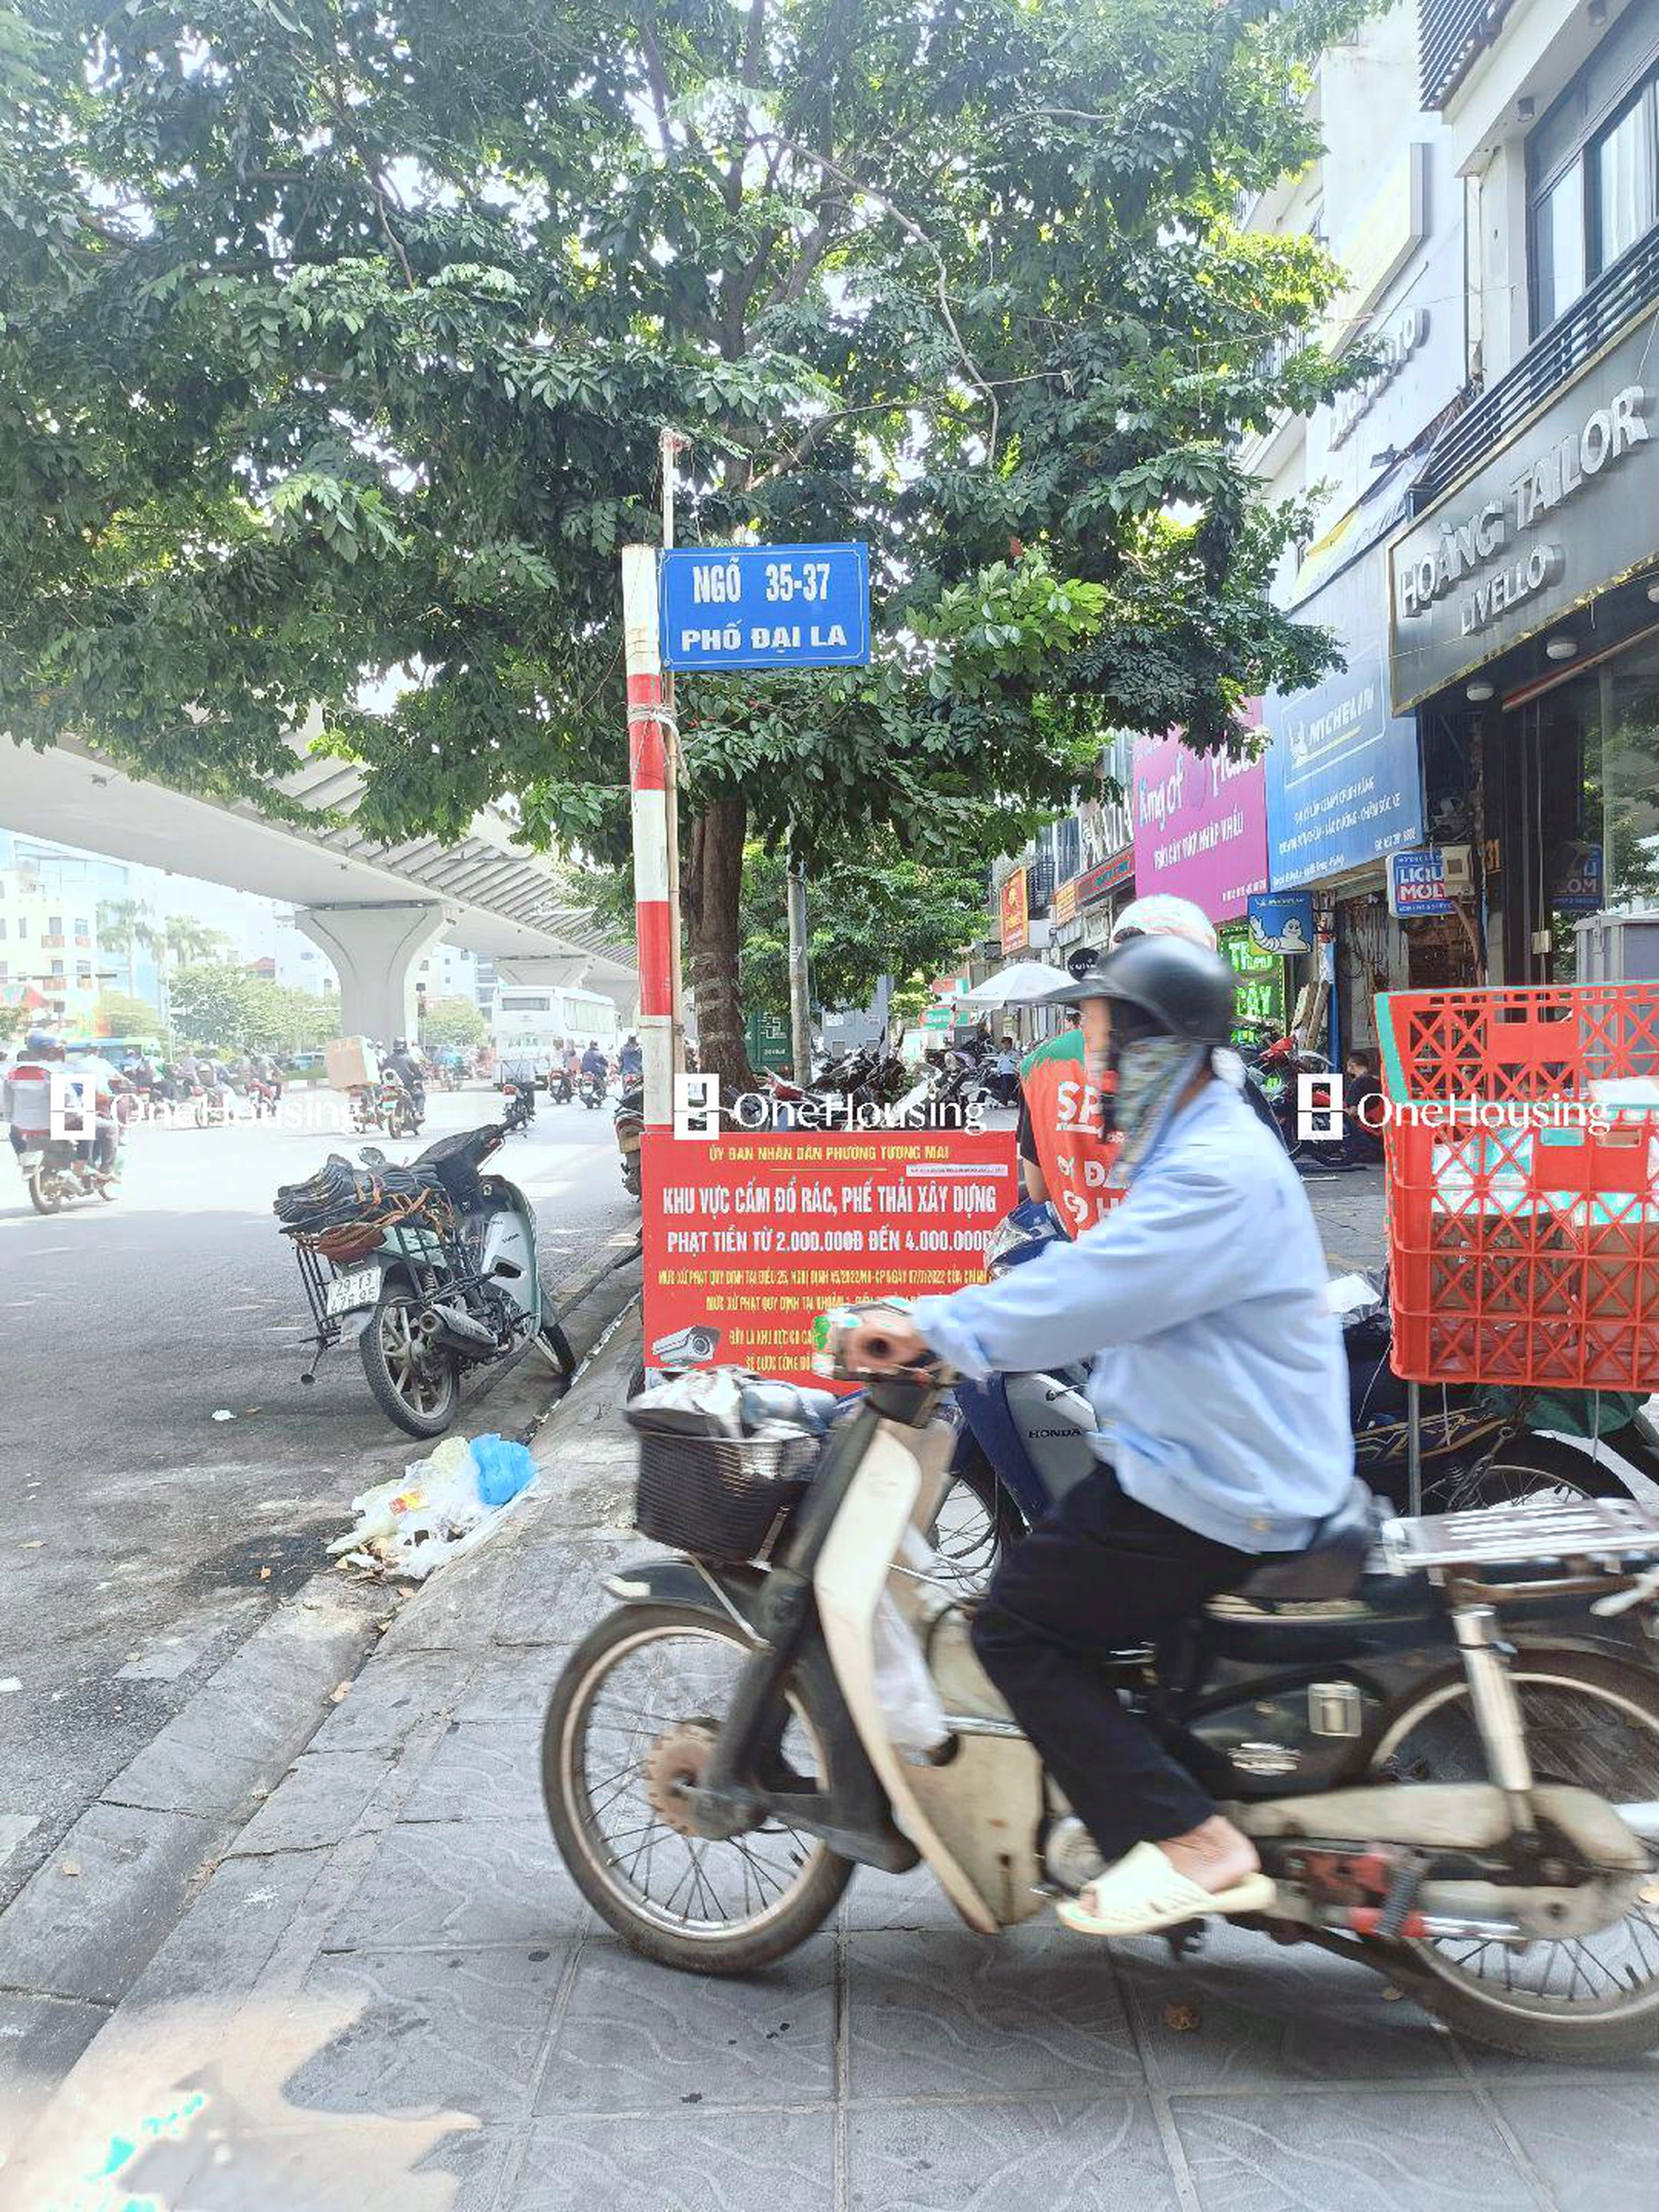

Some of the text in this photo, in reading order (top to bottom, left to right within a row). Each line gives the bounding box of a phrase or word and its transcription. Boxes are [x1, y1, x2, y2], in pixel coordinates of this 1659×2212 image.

[1401, 386, 1650, 617] HOÀNG TAILOR
[693, 555, 831, 603] NGÕ 35-37
[1461, 543, 1560, 636] LIVELLO
[681, 619, 848, 654] PHỐ ĐẠI LA
[1309, 683, 1375, 746] MICHELIN
[1400, 866, 1445, 884] LIQU
[729, 1147, 753, 1161] BAN
[758, 1144, 792, 1161] NHÂN
[796, 1144, 822, 1160] DÂN
[826, 1144, 876, 1160] PHƯỜNG
[881, 1145, 921, 1159] TƯƠNG
[925, 1145, 949, 1158] MAI
[663, 1176, 997, 1220] KHU VỰC CẤM ĐỔ RÁC, PHẾ THẢI XÂY DỰNG
[668, 1231, 708, 1257] PHẠT
[712, 1225, 747, 1252] TIỀN
[752, 1226, 774, 1252] TỪ
[868, 1224, 901, 1251] ĐẾN
[1029, 1428, 1082, 1439] HONDA
